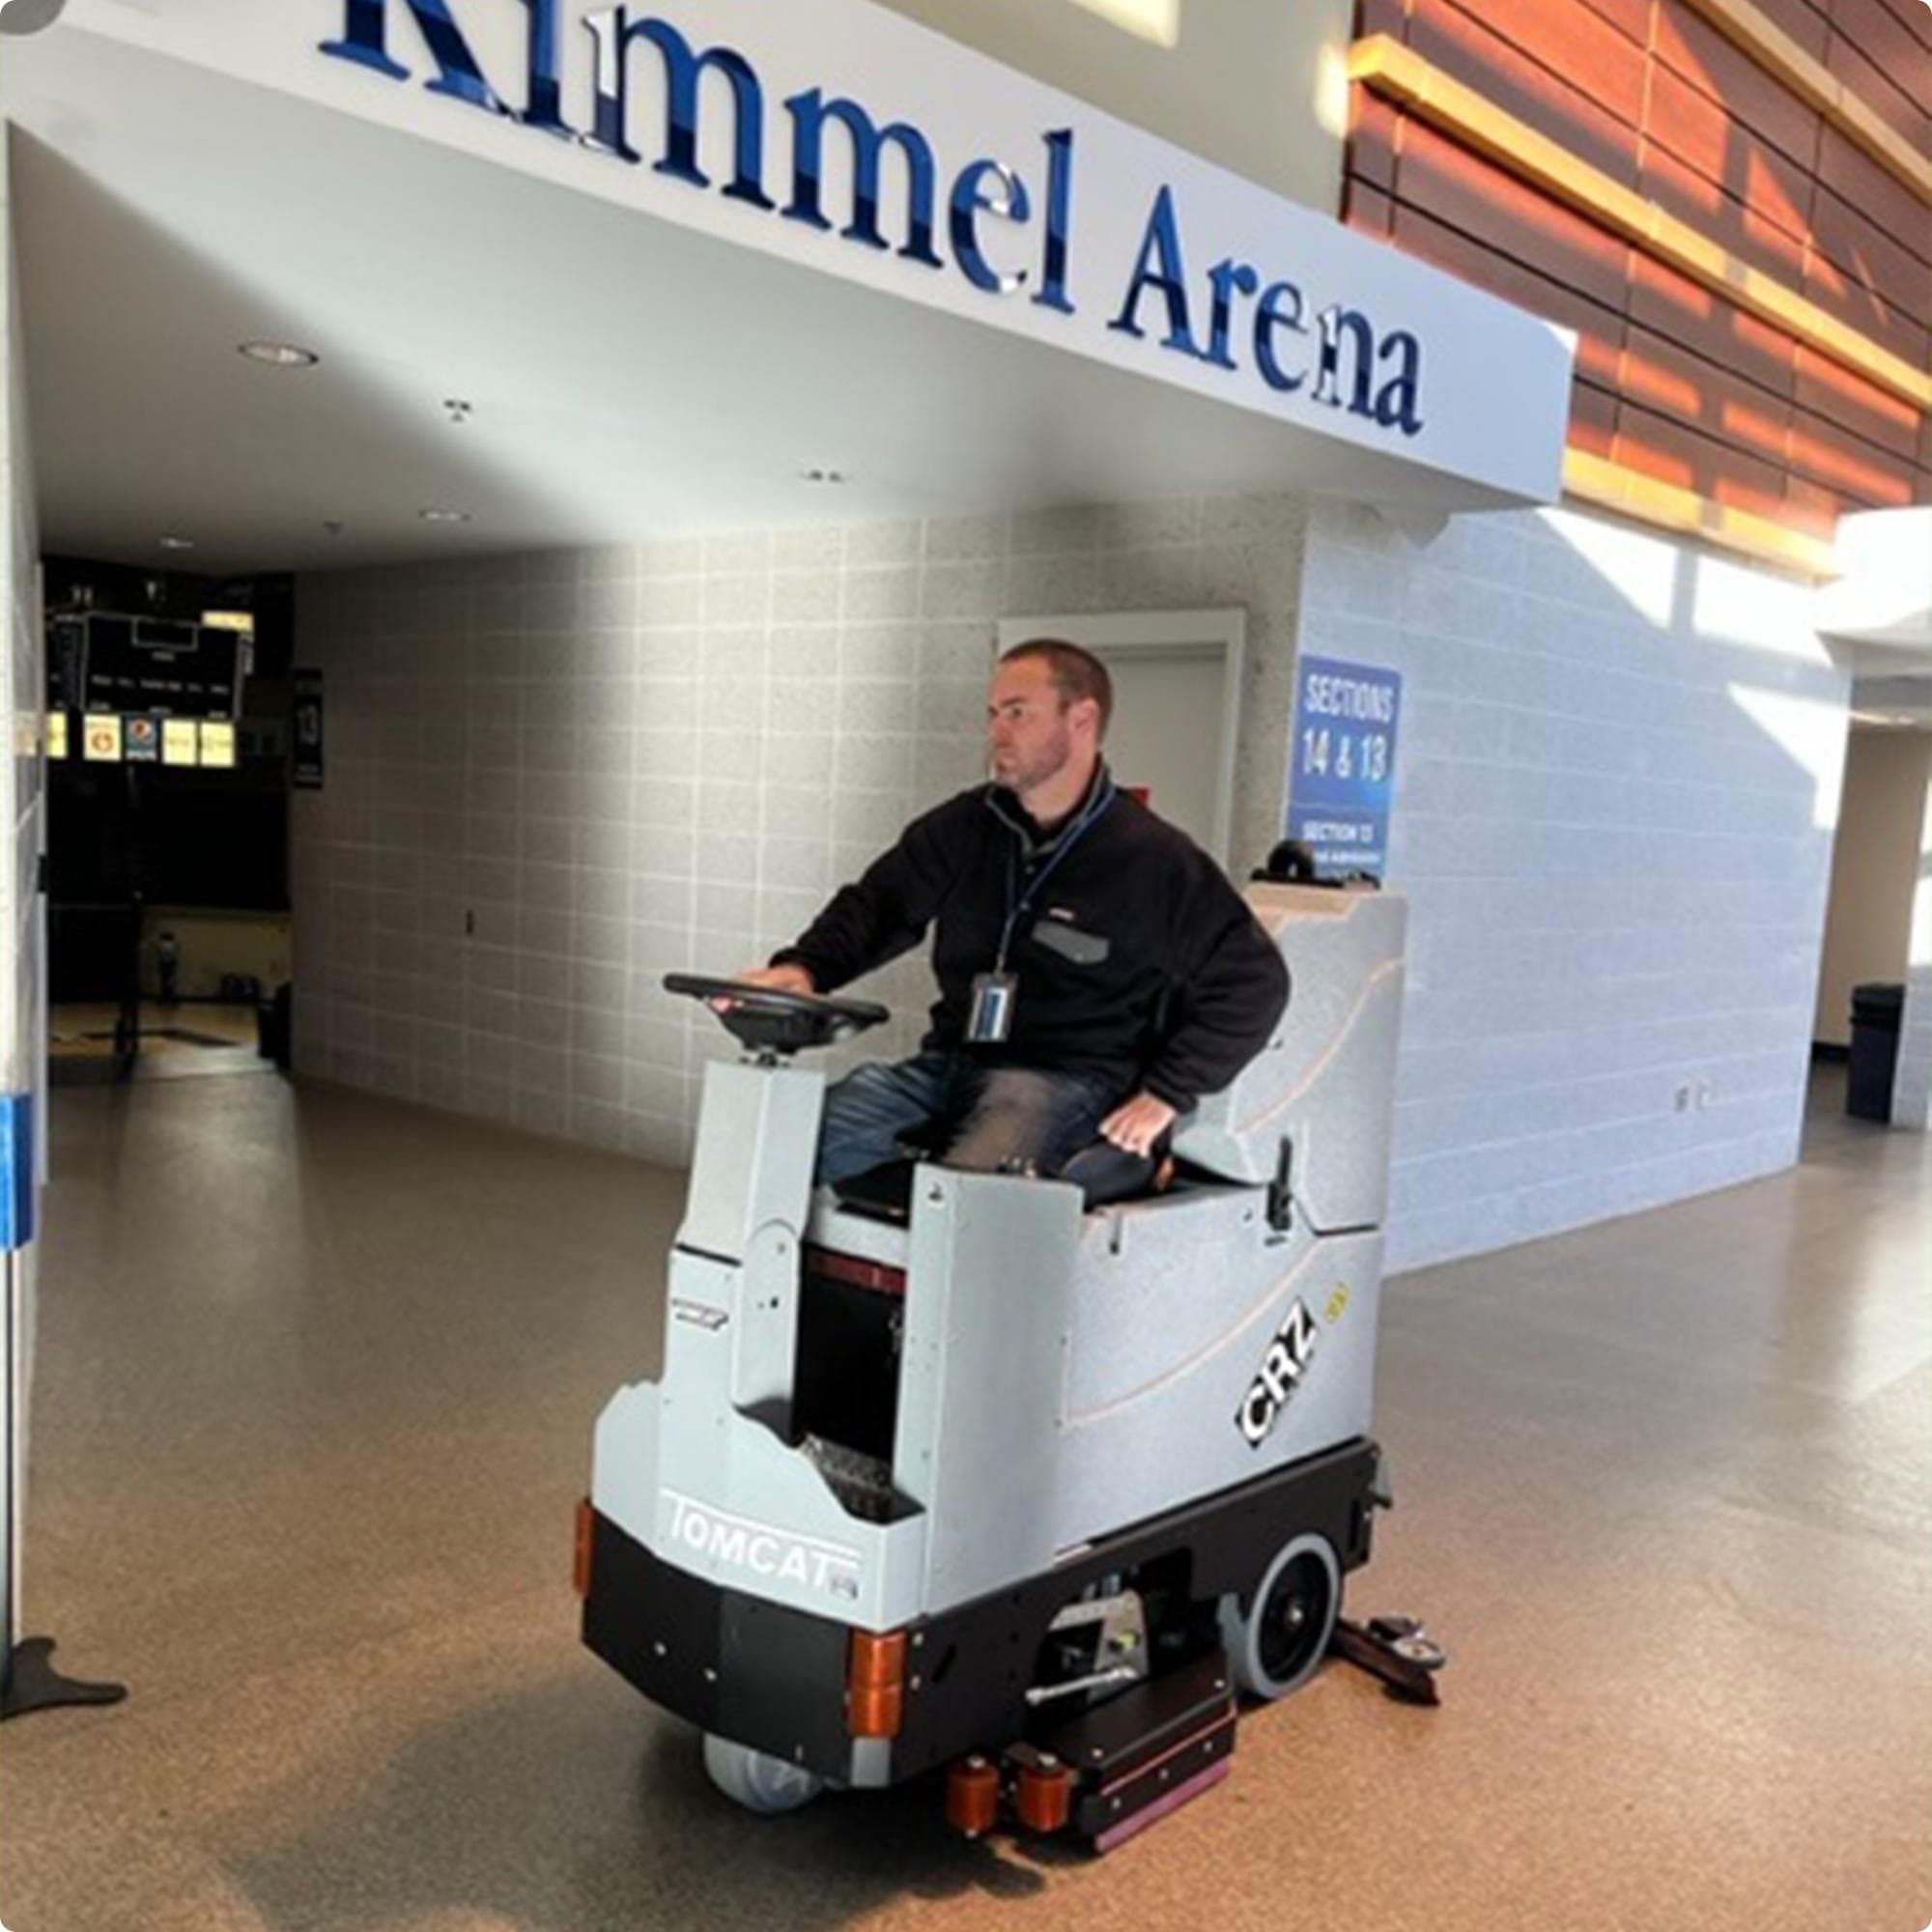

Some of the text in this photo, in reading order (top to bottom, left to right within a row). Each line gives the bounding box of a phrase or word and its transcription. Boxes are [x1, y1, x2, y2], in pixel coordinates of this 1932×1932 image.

[1107, 184, 1422, 437] Arena
[1304, 673, 1394, 724] SECTIONS
[1302, 727, 1387, 781] 14 & 13
[1241, 1302, 1318, 1440] CRZ
[658, 1488, 861, 1590] TOMCAT
